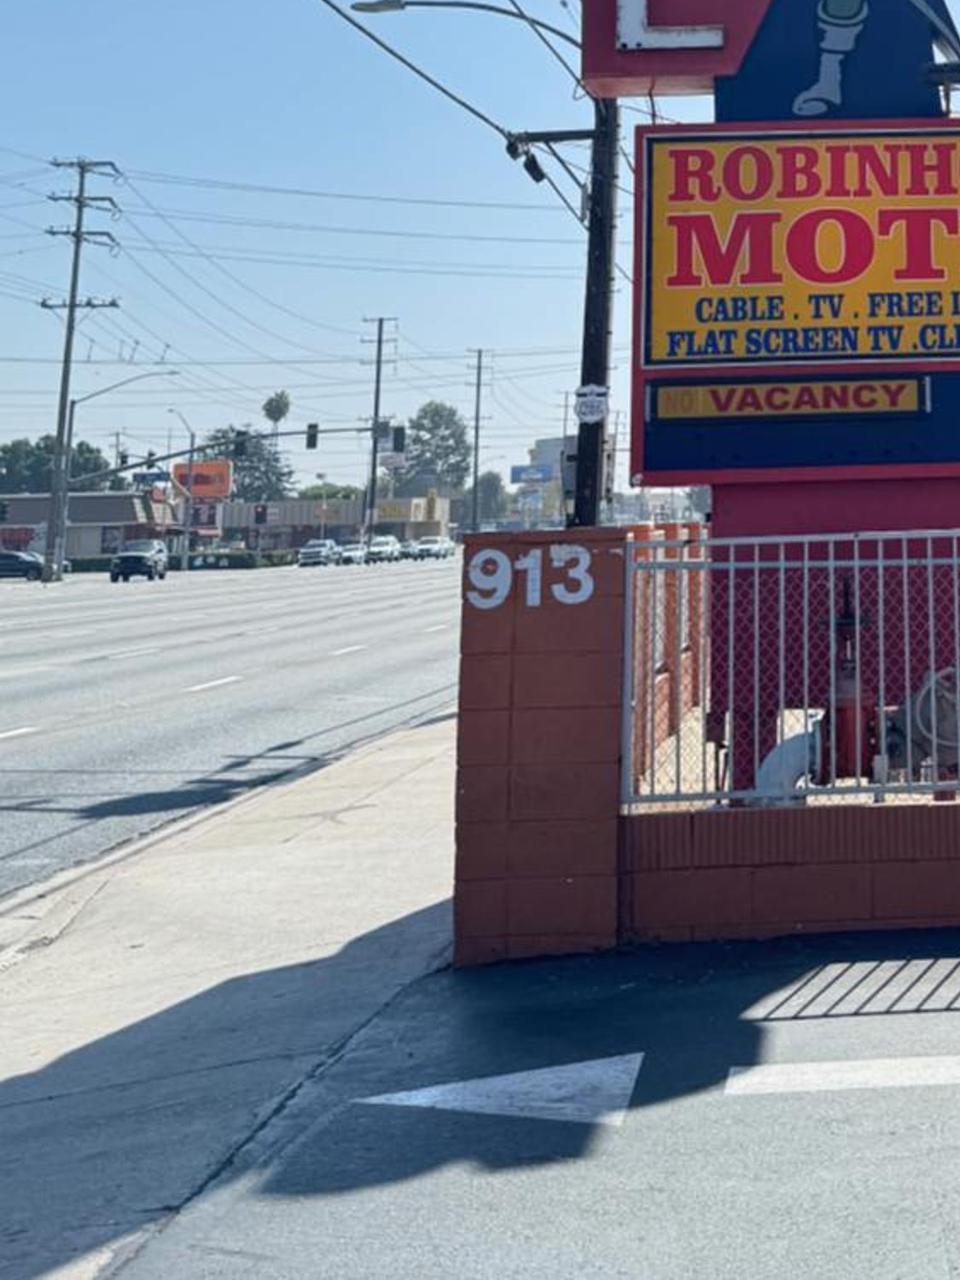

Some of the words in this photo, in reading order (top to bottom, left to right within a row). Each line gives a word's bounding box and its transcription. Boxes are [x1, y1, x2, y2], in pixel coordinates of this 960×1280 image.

[695, 294, 785, 322] CABLE
[808, 293, 845, 319] TV
[868, 291, 942, 318] FREE
[666, 329, 739, 357] FLAT
[745, 326, 860, 355] SCREEN
[867, 325, 906, 352] TV
[709, 383, 908, 413] VACANCY
[465, 544, 594, 609] 913
